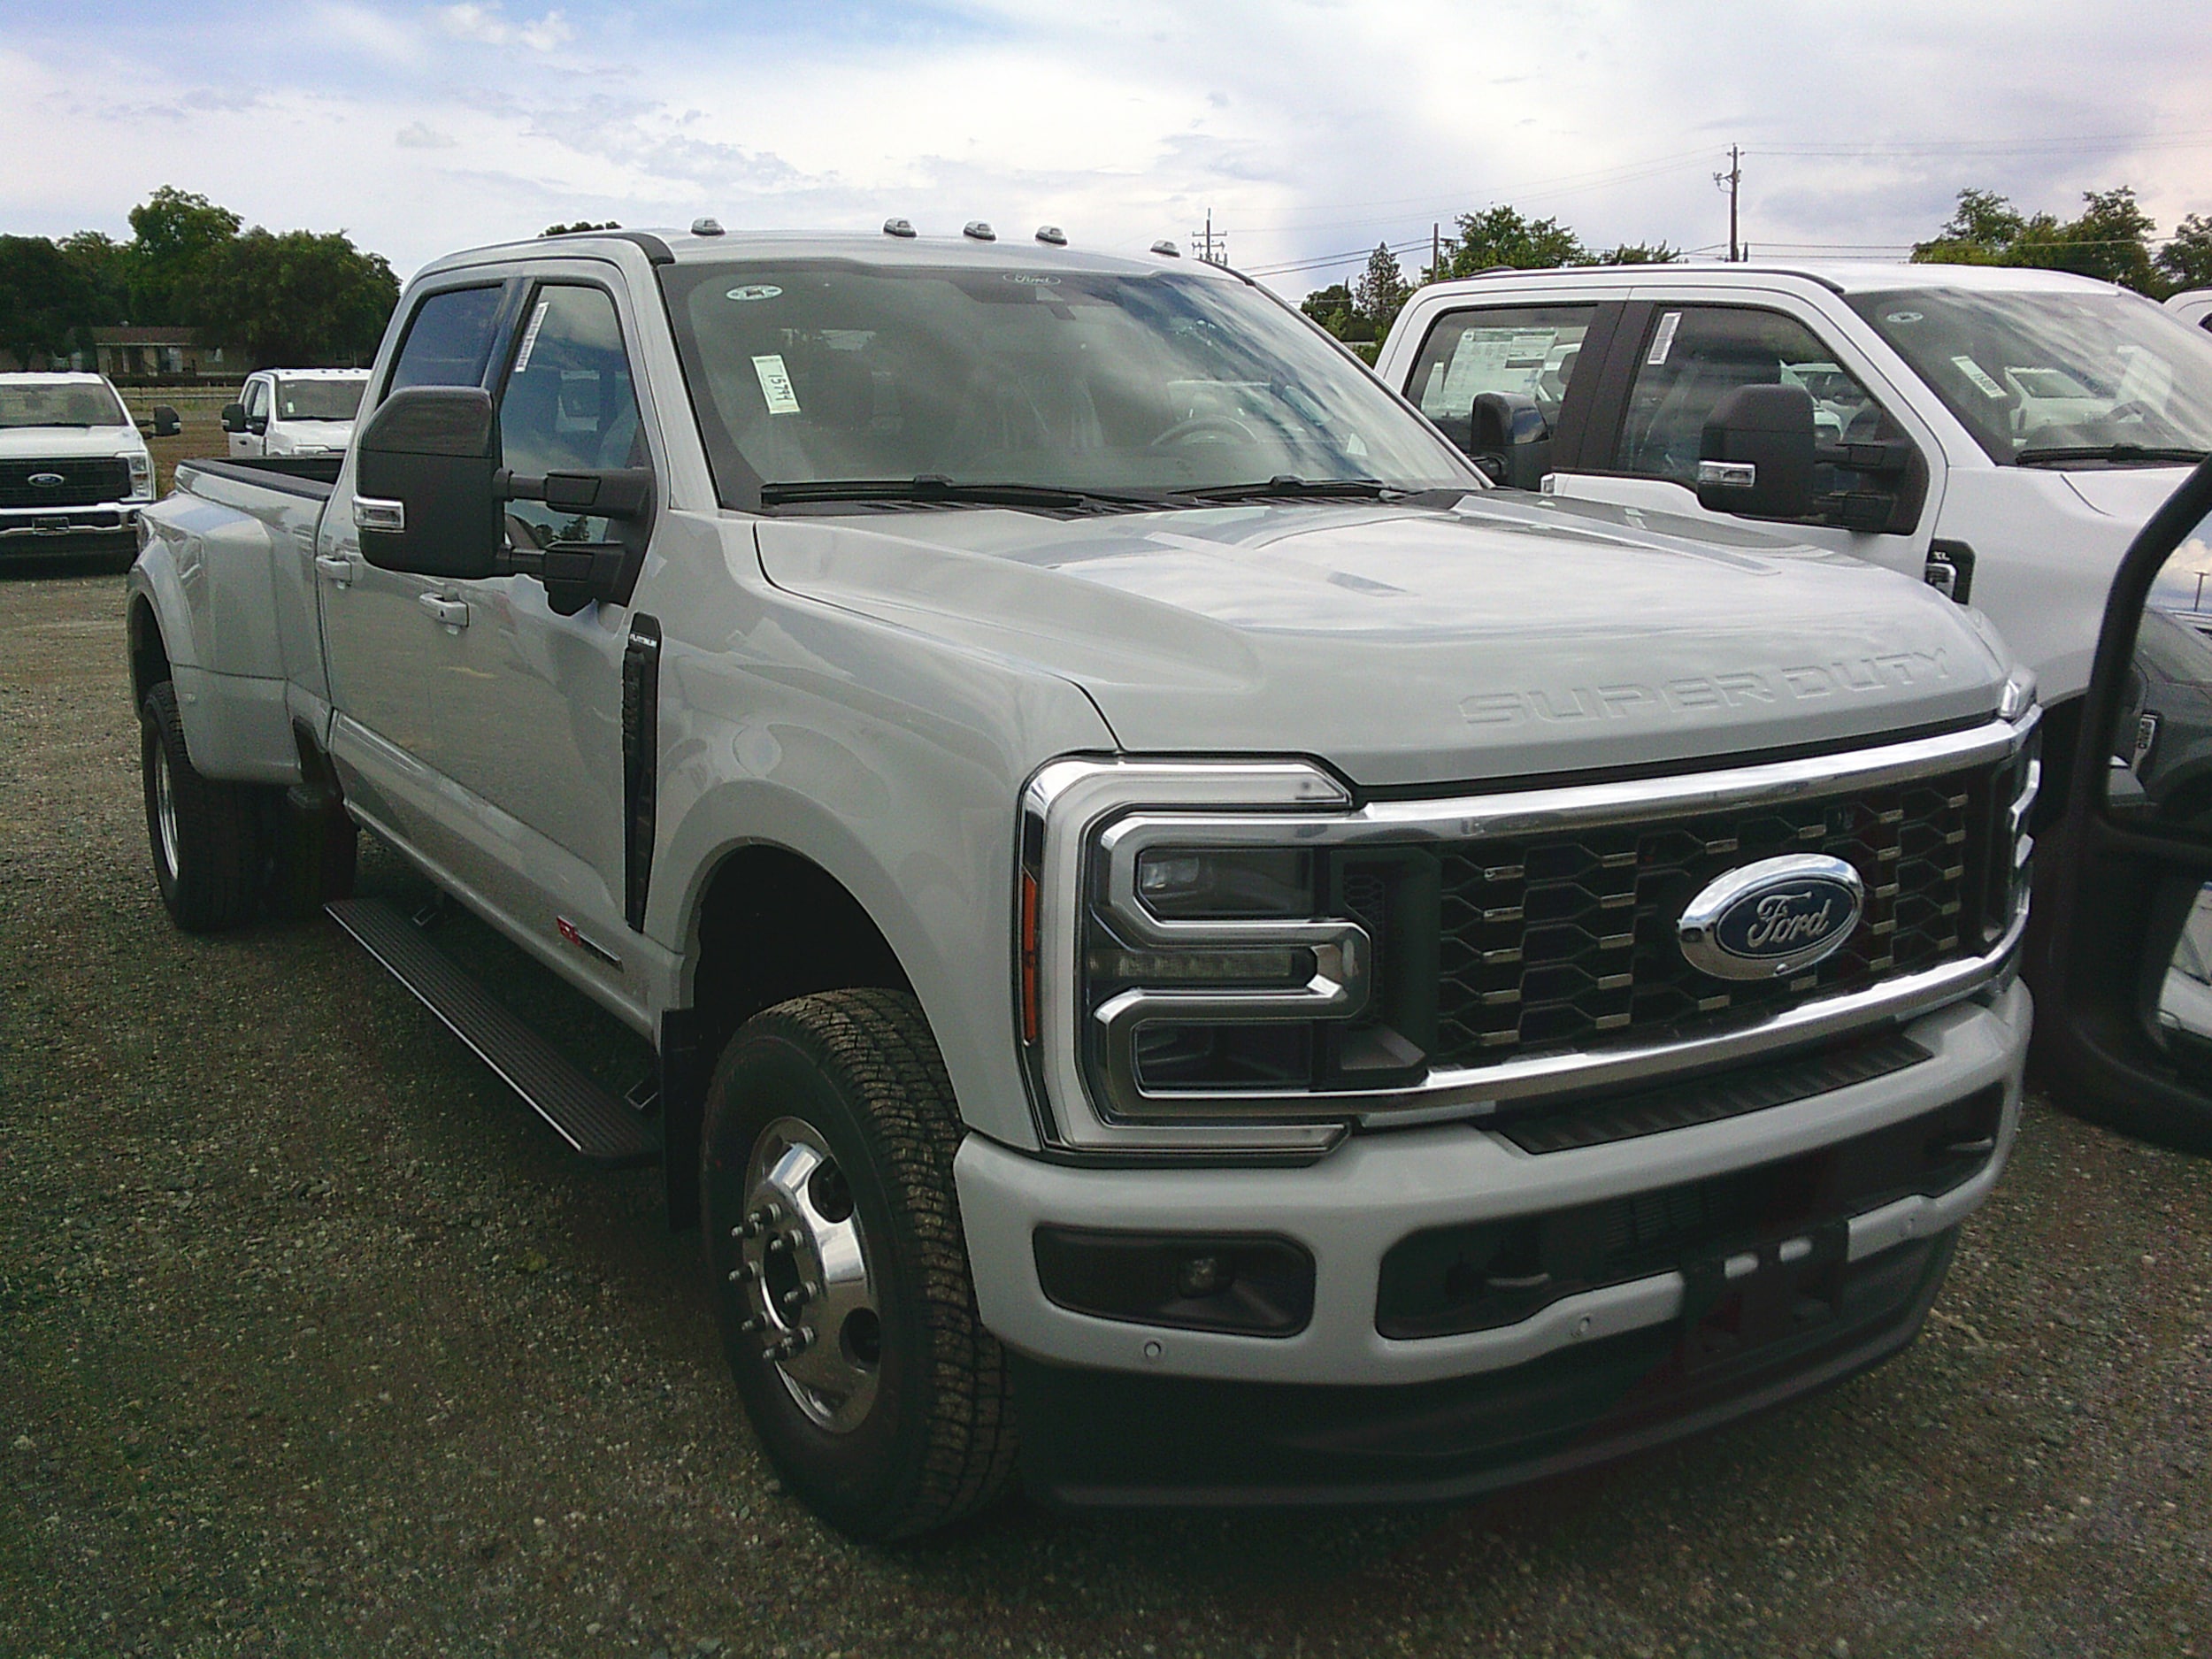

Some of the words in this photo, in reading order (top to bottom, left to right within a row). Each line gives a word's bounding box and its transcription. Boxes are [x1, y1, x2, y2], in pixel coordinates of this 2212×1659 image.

[1932, 550, 1950, 561] XL
[1458, 672, 1776, 724] SUPER
[1781, 647, 1948, 699] DUTY
[1747, 890, 1832, 948] Ford
